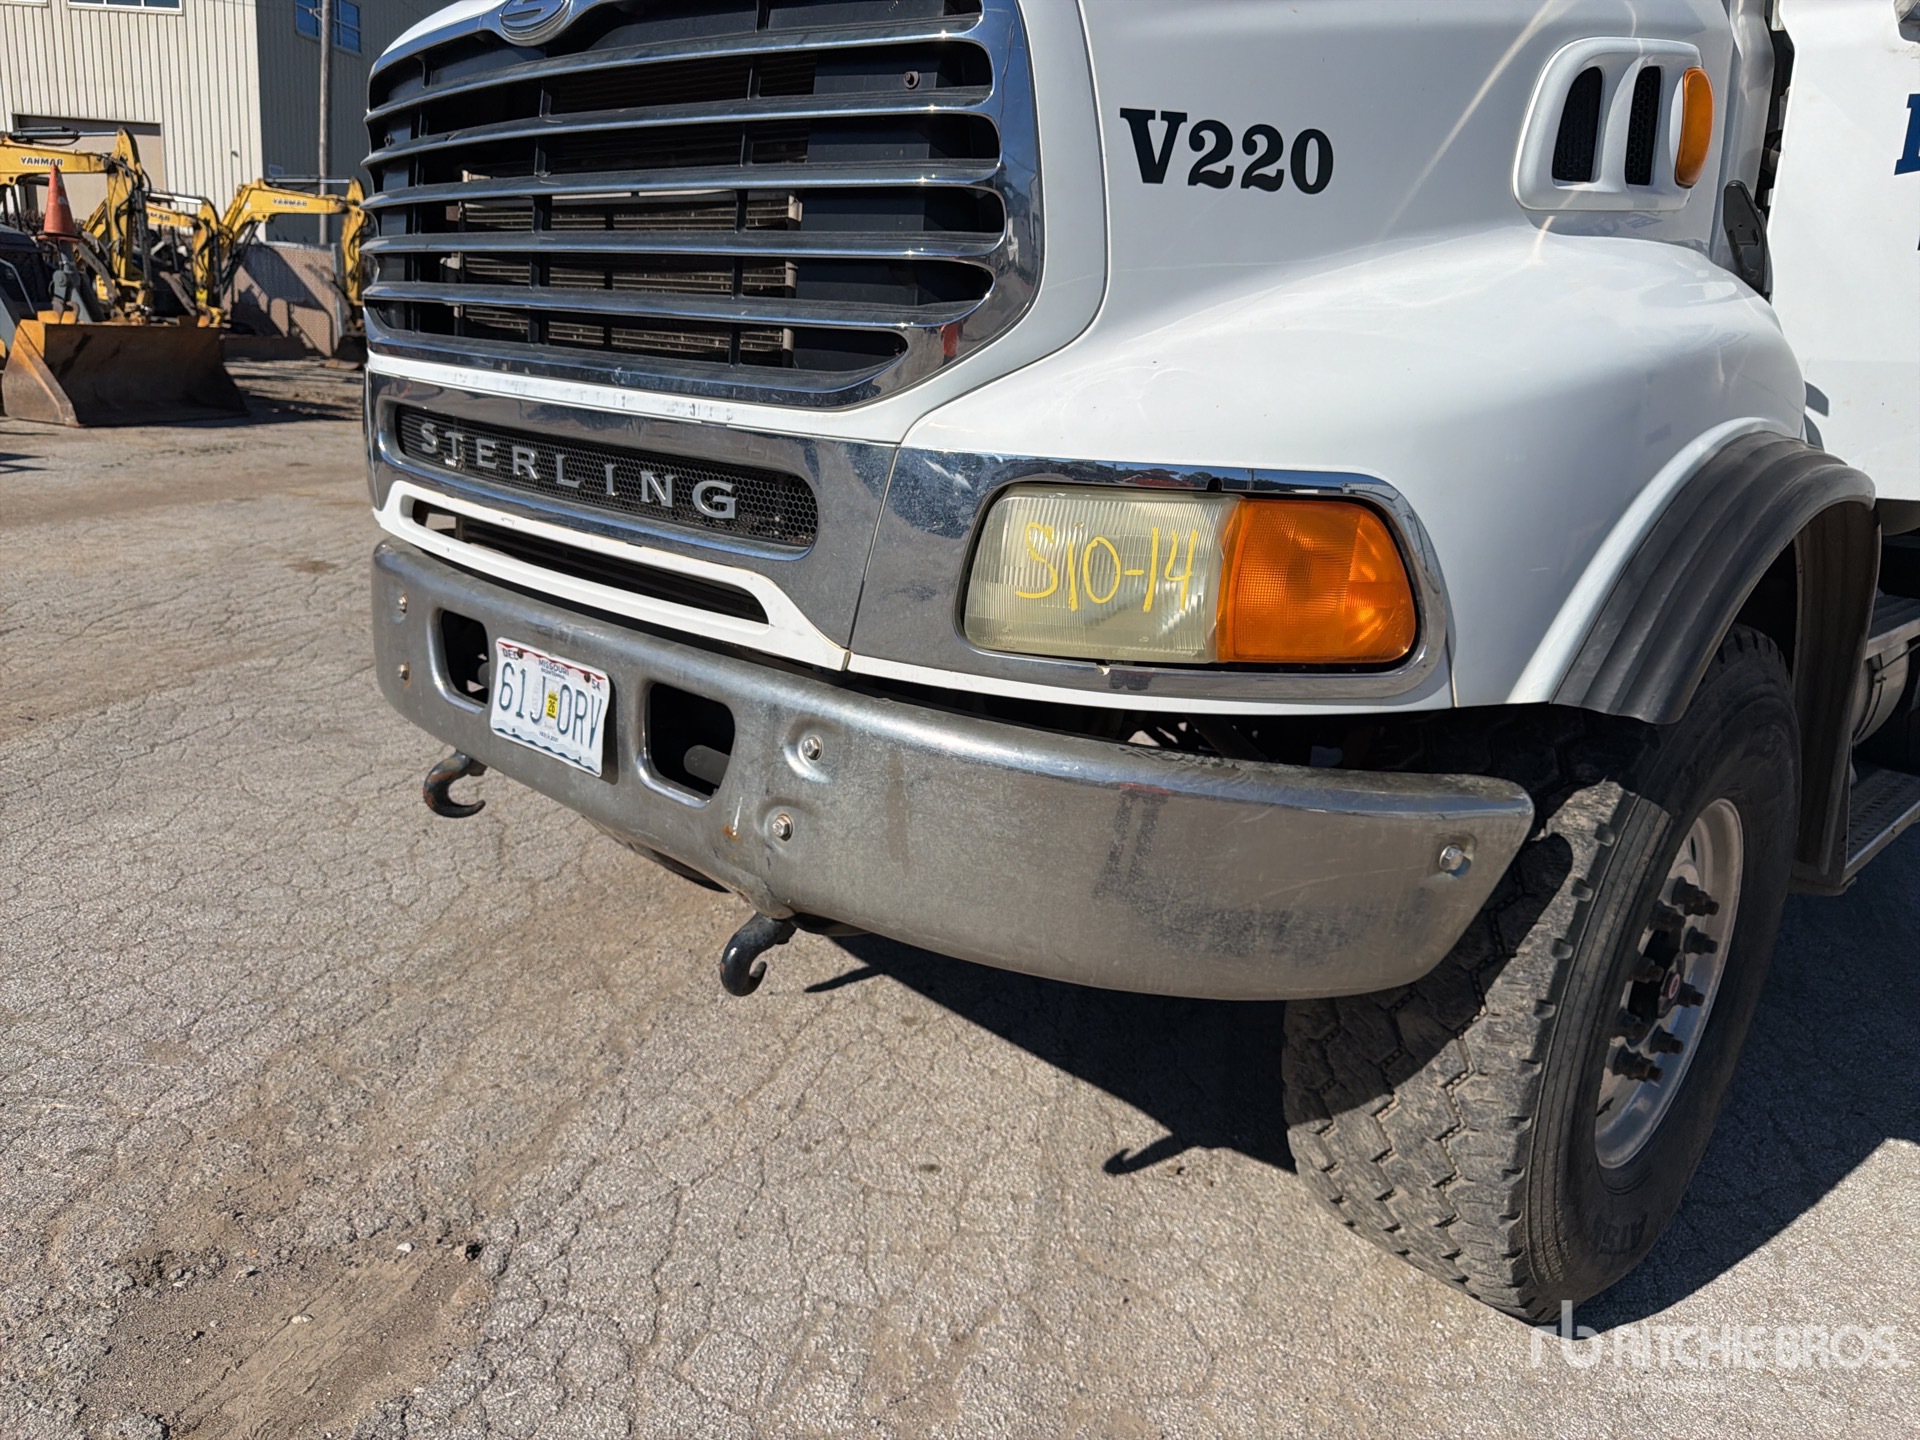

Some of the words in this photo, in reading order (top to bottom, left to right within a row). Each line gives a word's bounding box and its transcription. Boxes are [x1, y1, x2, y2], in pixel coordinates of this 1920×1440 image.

[1119, 108, 1334, 194] V220
[20, 156, 64, 166] YANMAR
[272, 198, 308, 207] YANMAR
[419, 421, 738, 520] STERLING
[1015, 521, 1199, 612] S10-14
[502, 648, 519, 661] DEC
[538, 658, 570, 676] MISSOURI
